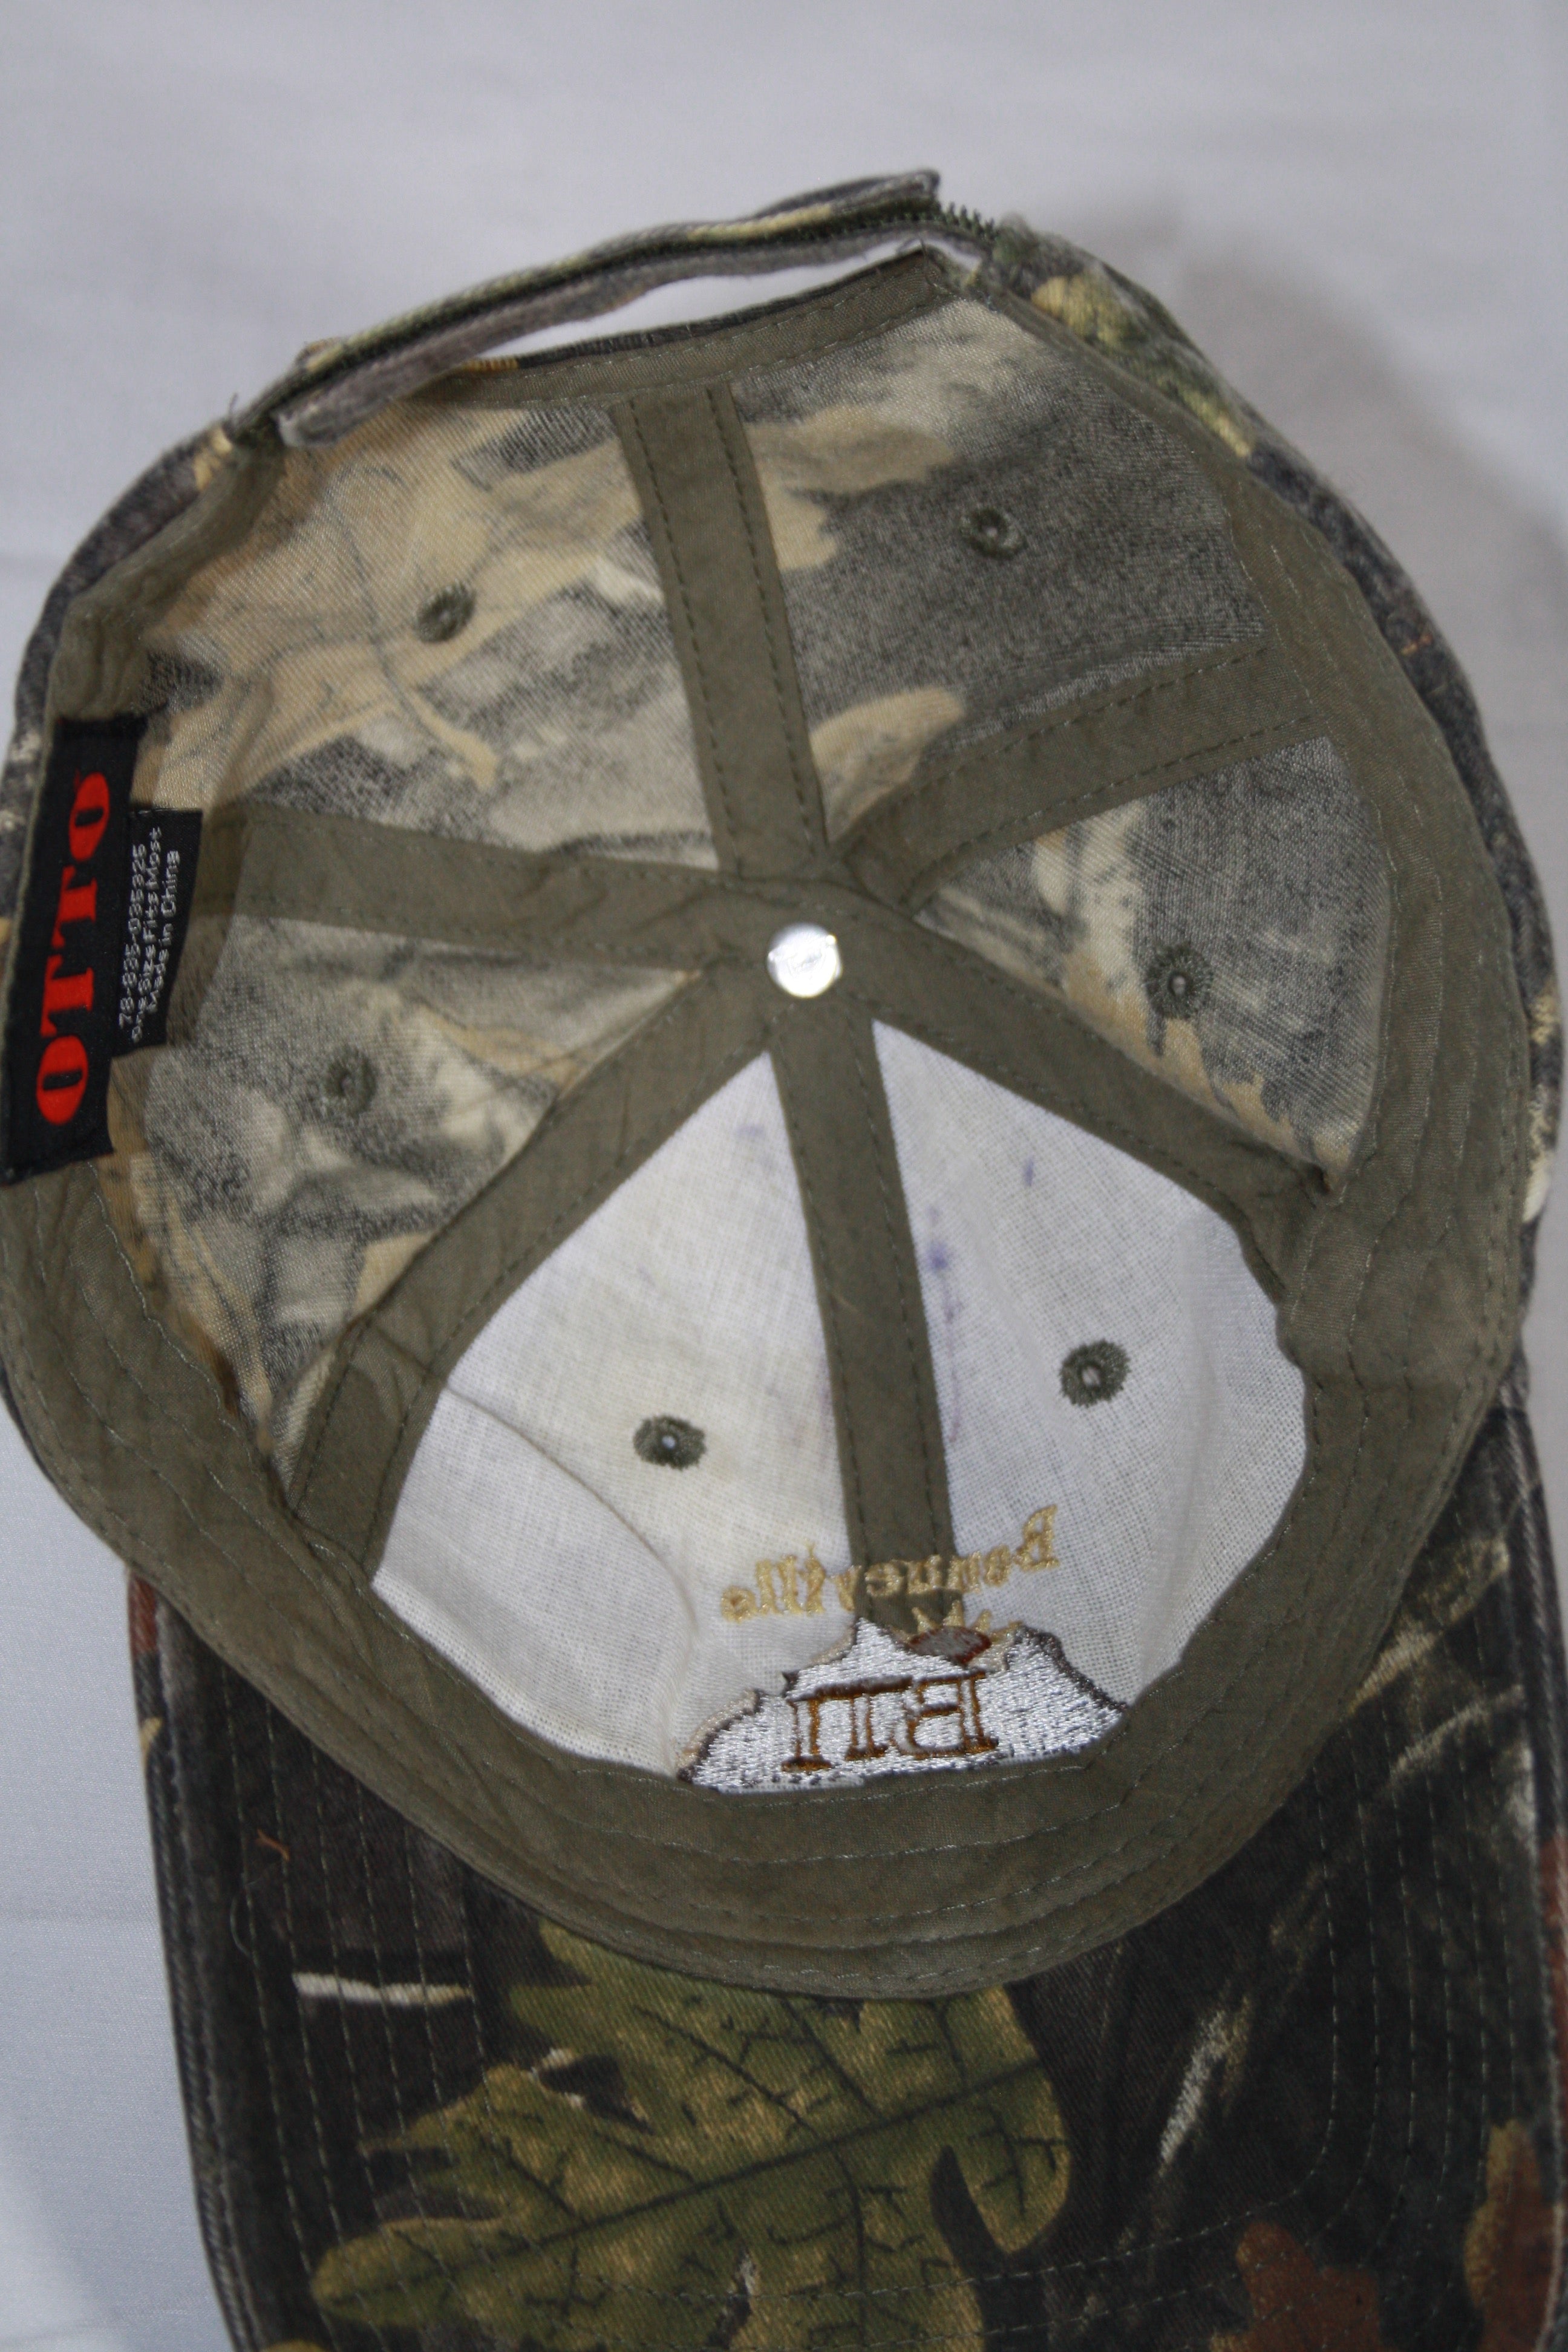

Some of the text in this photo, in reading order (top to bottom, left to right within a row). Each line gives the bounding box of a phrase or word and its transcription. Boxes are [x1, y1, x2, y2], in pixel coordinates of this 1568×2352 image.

[145, 827, 162, 889] Most
[142, 892, 160, 942] Fits
[146, 851, 180, 1014] Made in China
[36, 773, 109, 1124] OTTO
[137, 945, 155, 996] Size
